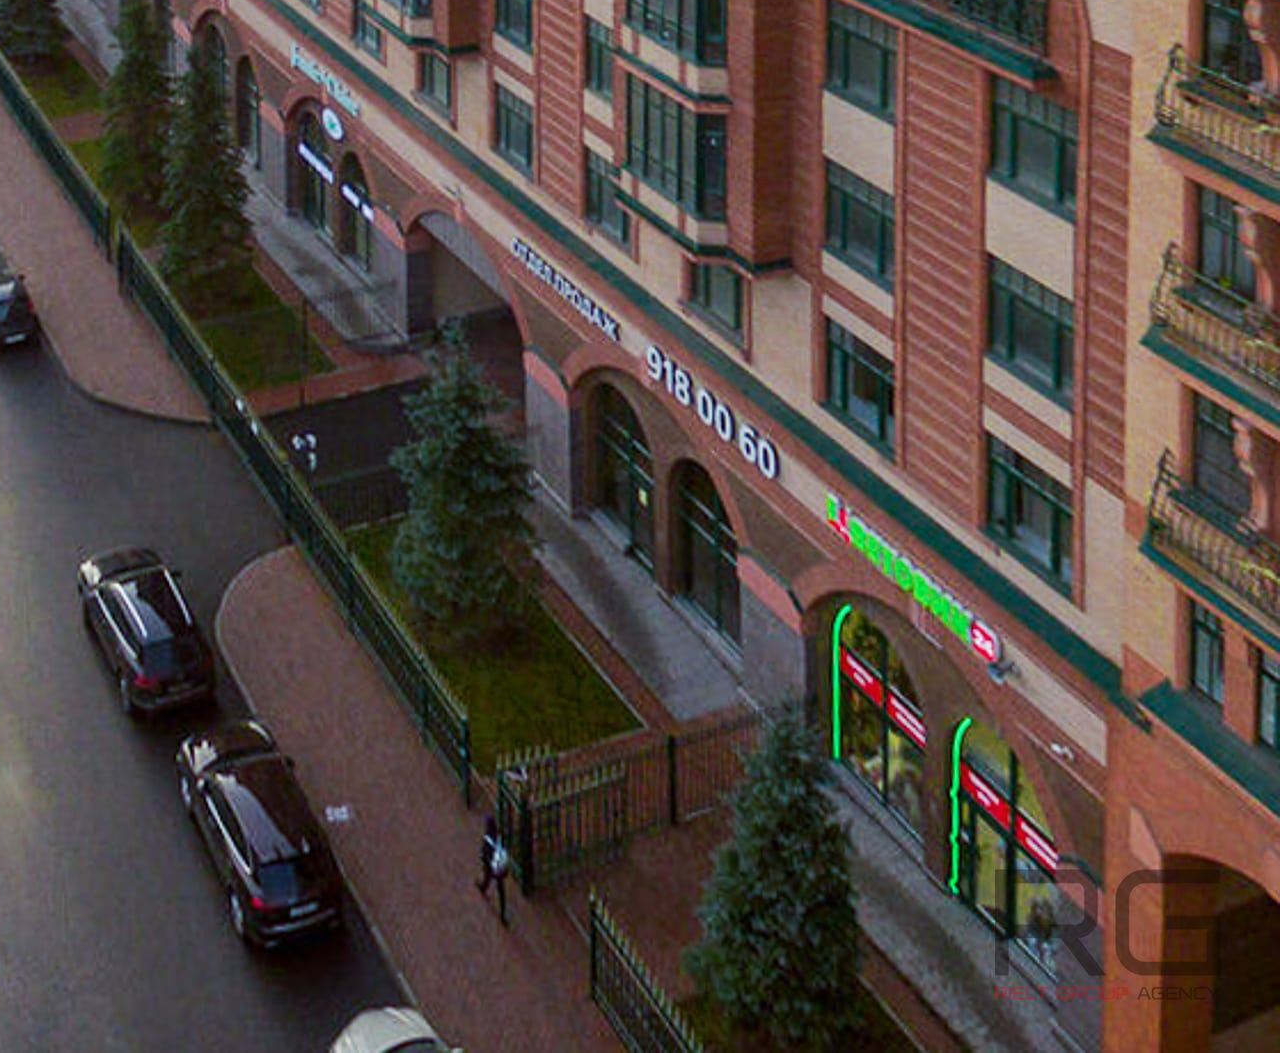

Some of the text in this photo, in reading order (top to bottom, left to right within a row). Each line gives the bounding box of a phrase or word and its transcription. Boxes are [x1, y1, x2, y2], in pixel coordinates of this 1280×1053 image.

[553, 271, 621, 342] ПРОДАЖ
[646, 346, 694, 407] 918
[697, 388, 734, 442] 00
[738, 424, 779, 479] 60
